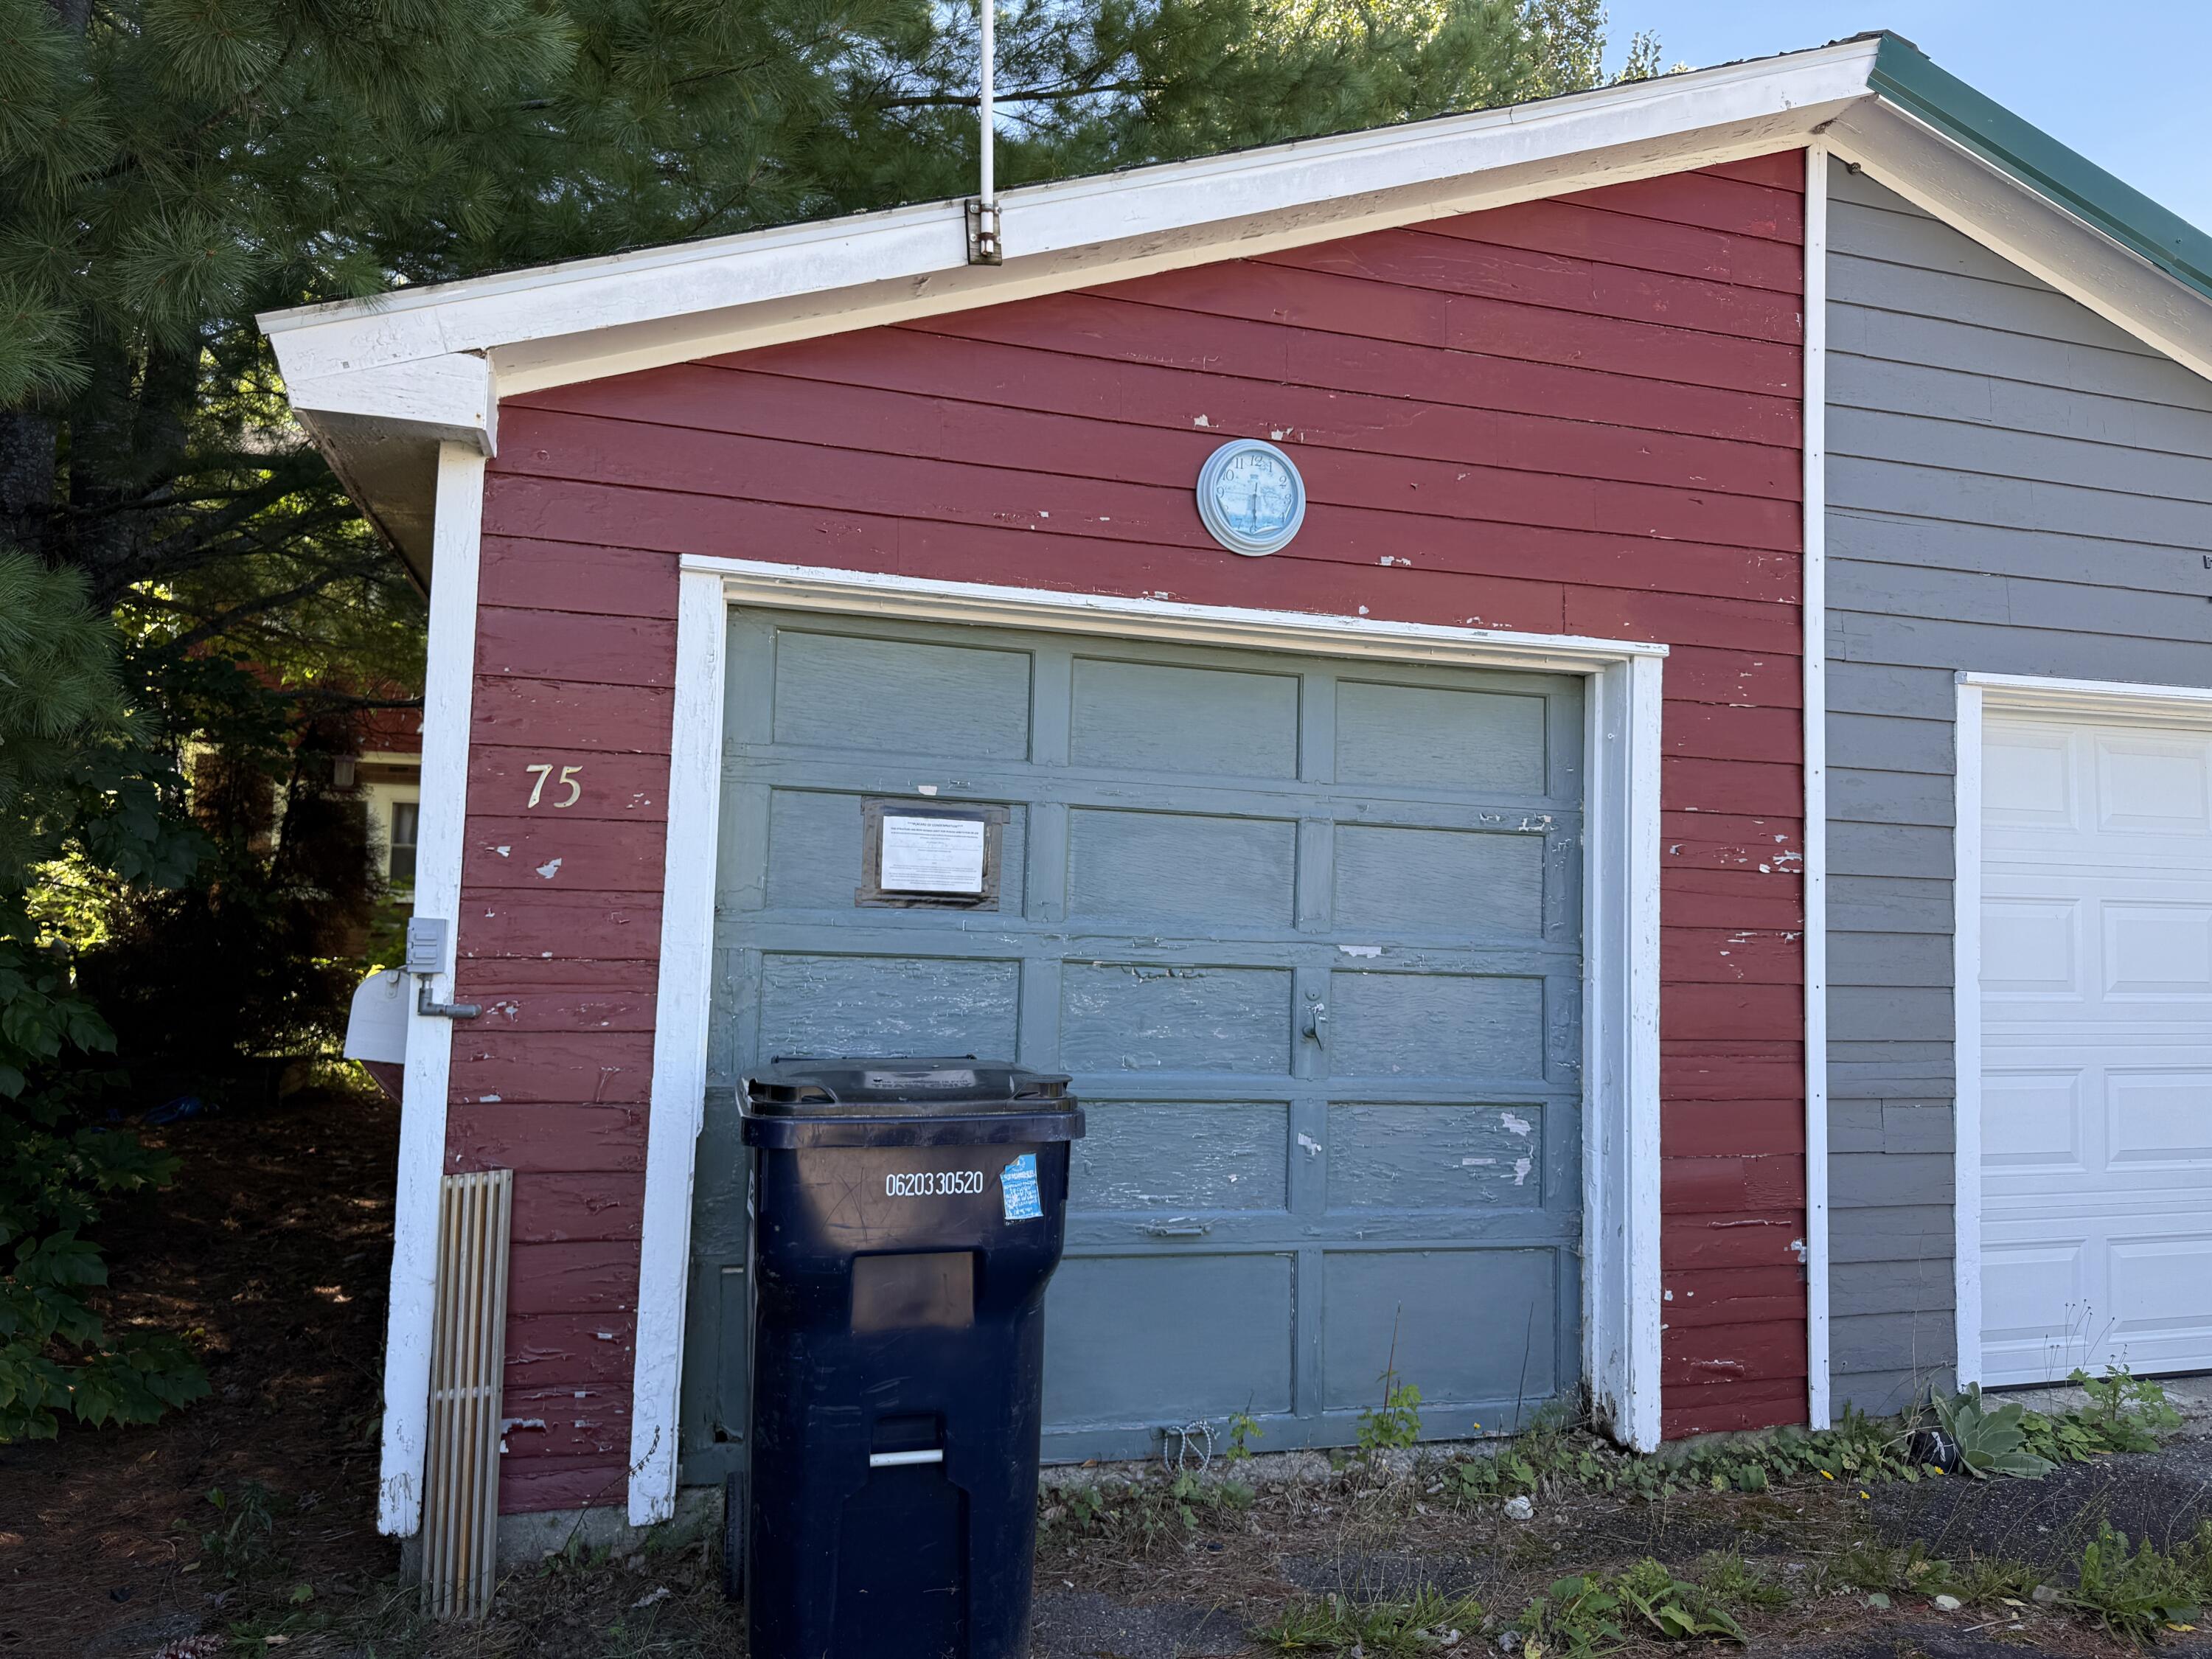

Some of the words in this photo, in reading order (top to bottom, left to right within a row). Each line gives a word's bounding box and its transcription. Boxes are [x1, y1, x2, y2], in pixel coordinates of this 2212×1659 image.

[1234, 458, 1244, 469] 11
[1251, 455, 1263, 467] 12
[1222, 469, 1234, 481] 10
[1279, 476, 1287, 488] 2
[1217, 487, 1225, 498] 9
[1284, 493, 1292, 505] 3
[1235, 518, 1242, 529] 7
[526, 763, 583, 809] 75
